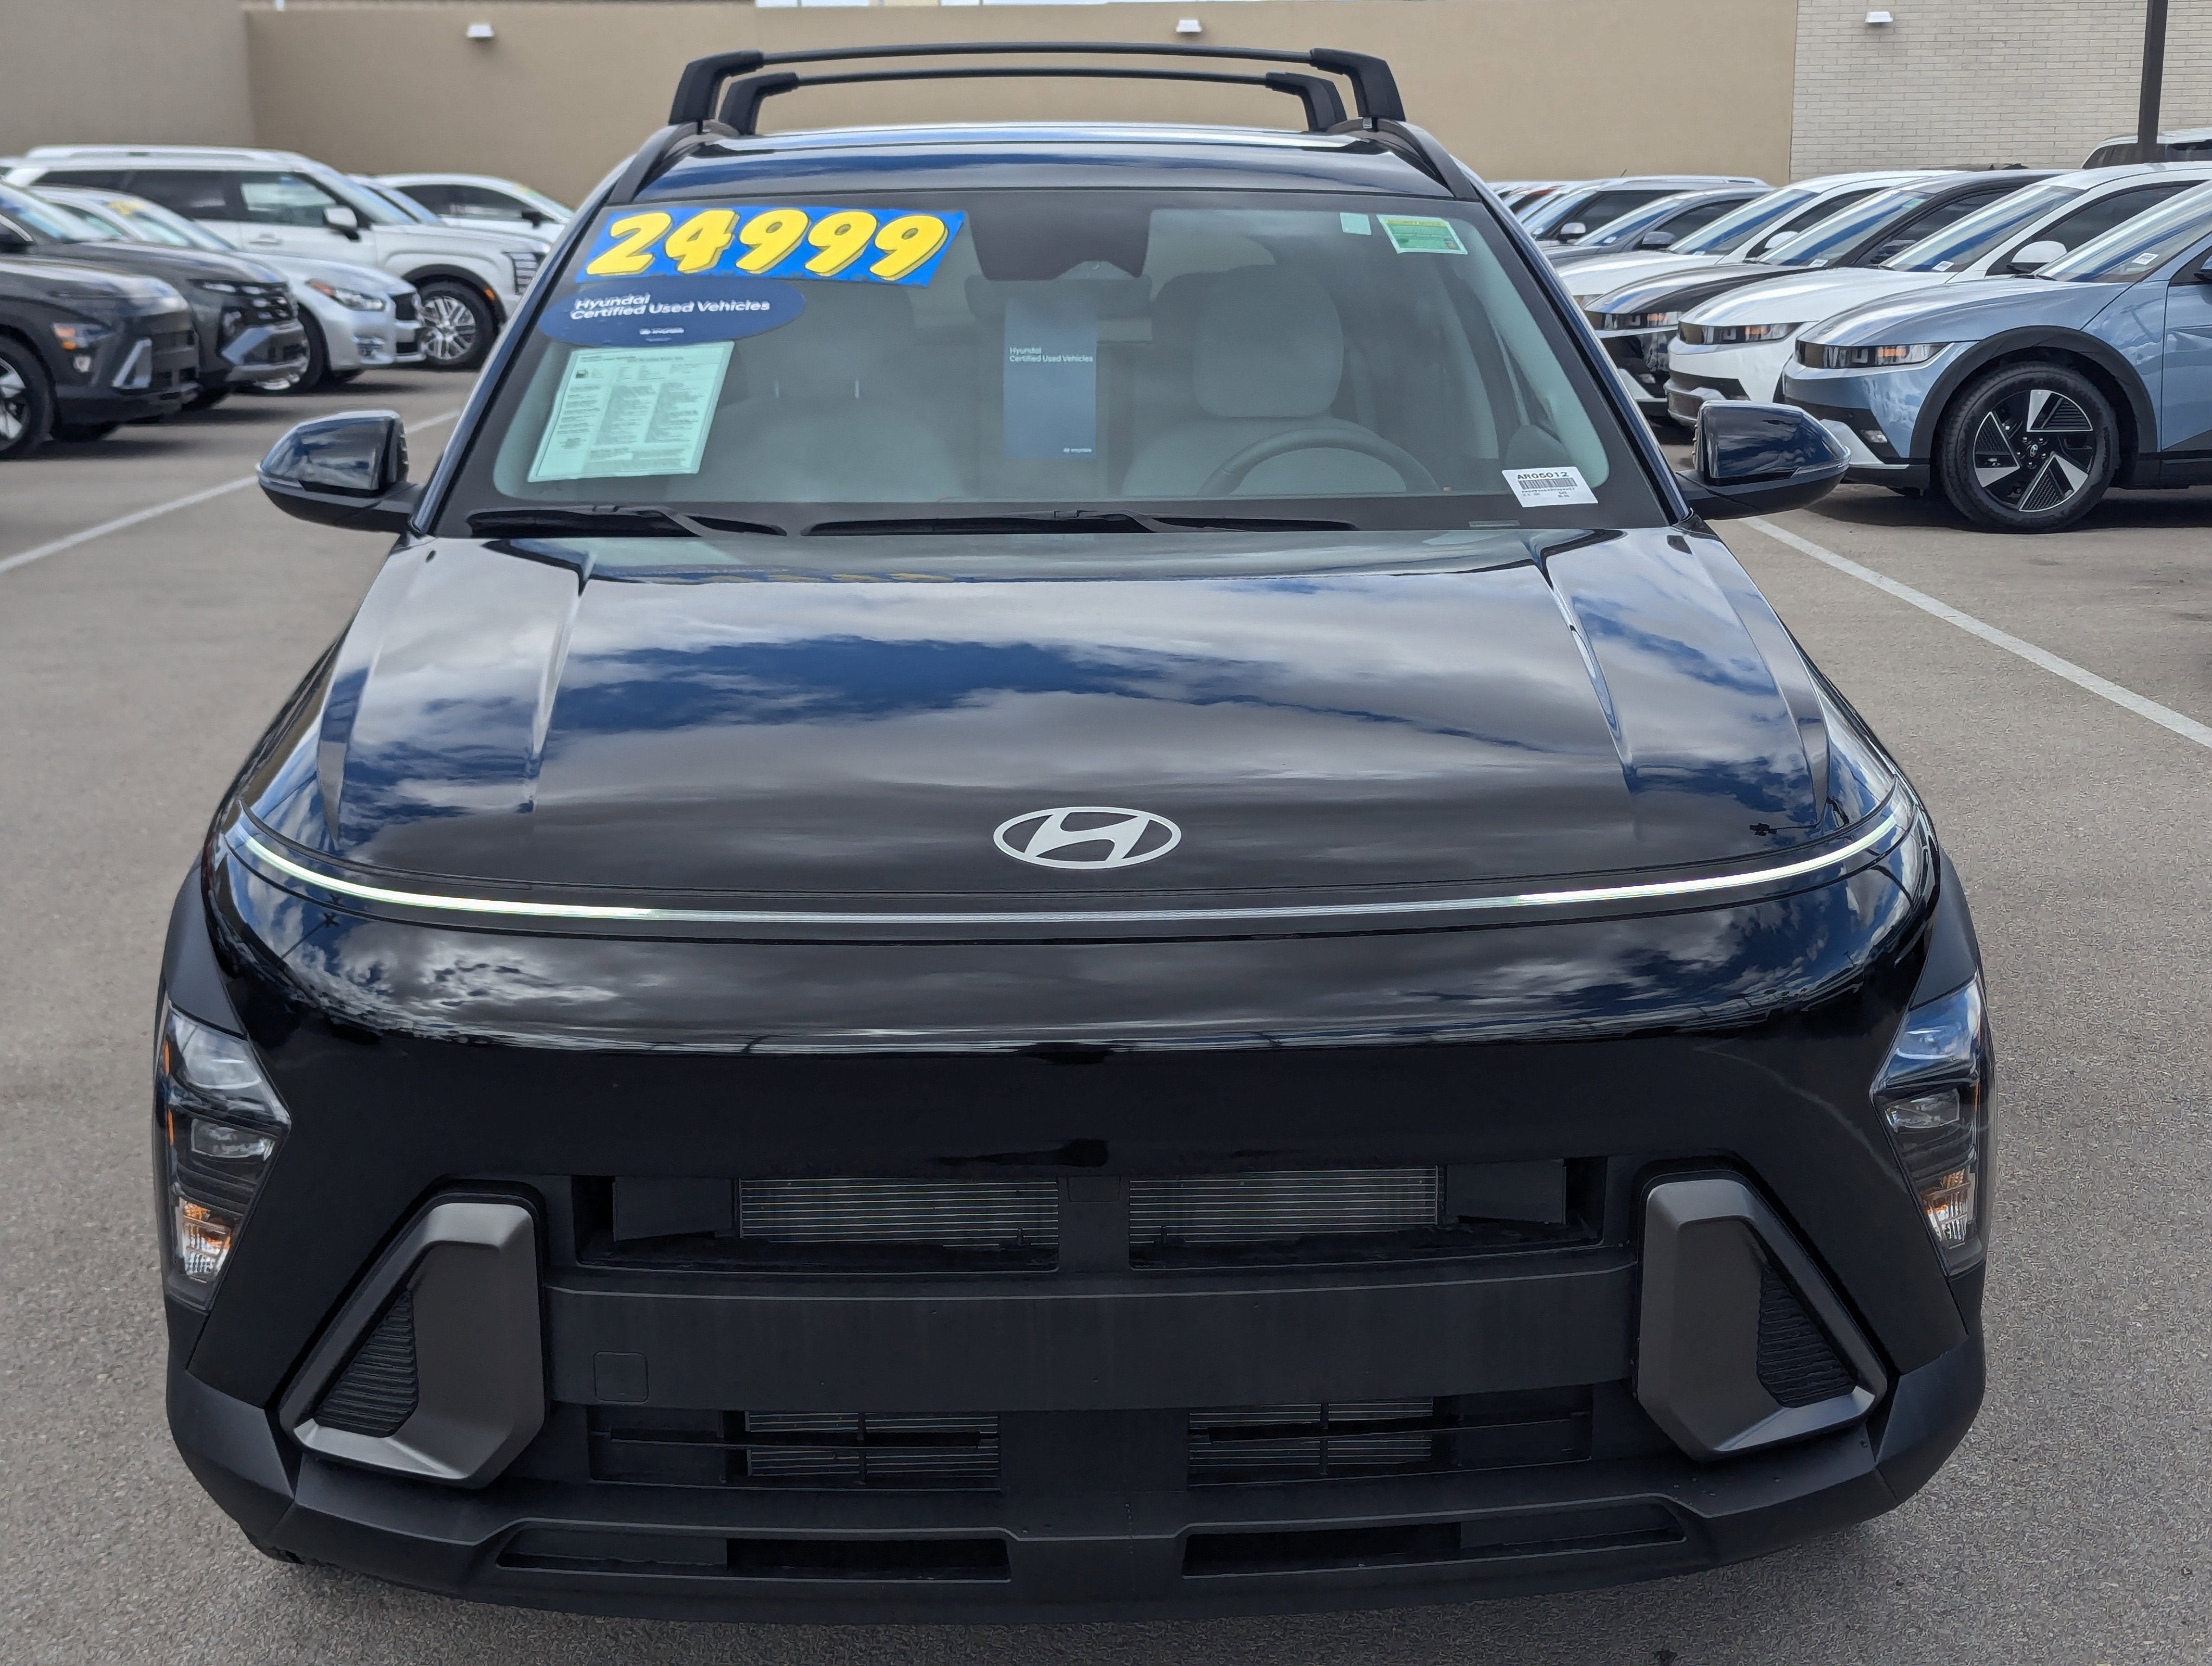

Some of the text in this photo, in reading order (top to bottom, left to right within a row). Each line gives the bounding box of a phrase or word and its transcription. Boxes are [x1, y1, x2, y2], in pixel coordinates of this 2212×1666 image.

[586, 209, 948, 280] 24999
[570, 299, 770, 319] Certified Used Vehicles
[575, 293, 651, 310] Hyundai
